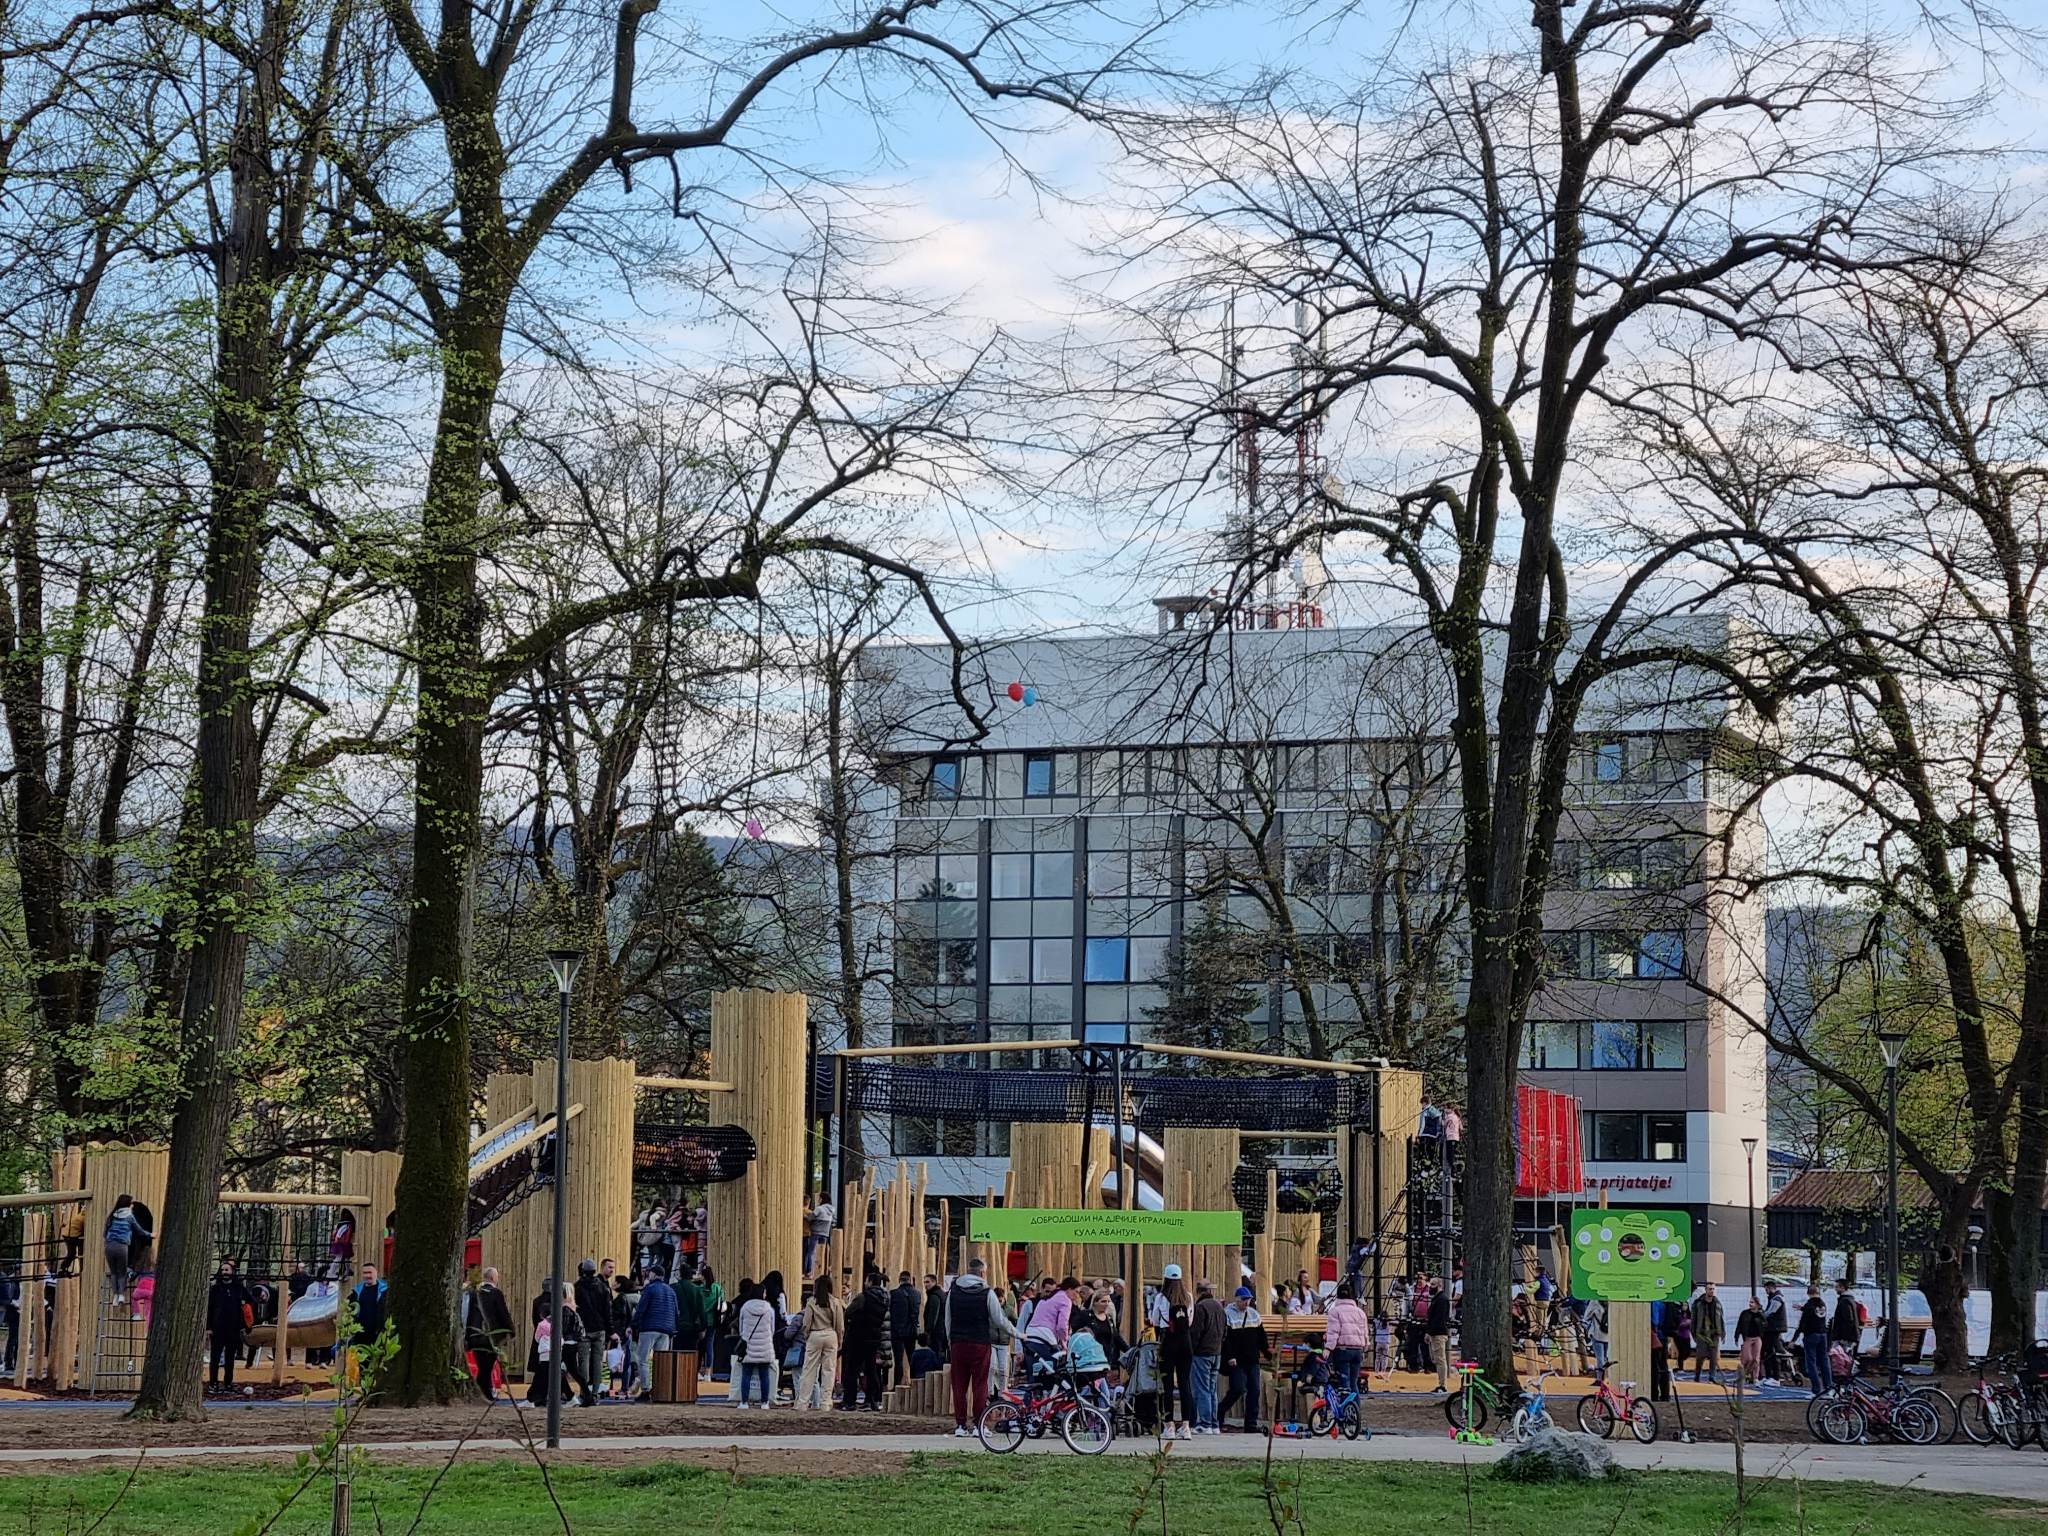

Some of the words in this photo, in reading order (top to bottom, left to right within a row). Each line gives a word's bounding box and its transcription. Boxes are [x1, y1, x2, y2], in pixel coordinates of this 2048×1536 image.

[1600, 1175, 1673, 1191] prijatelje!
[1030, 1215, 1091, 1225] ДОБРОДОШЛИ
[1093, 1215, 1104, 1223] НА
[1106, 1215, 1137, 1224] ДЈЕЧИЈЕ
[1138, 1215, 1185, 1227] ИГРАЛИШТЕ
[1074, 1228, 1097, 1237] КУЛА
[1099, 1228, 1142, 1238] АВАНТУРА
